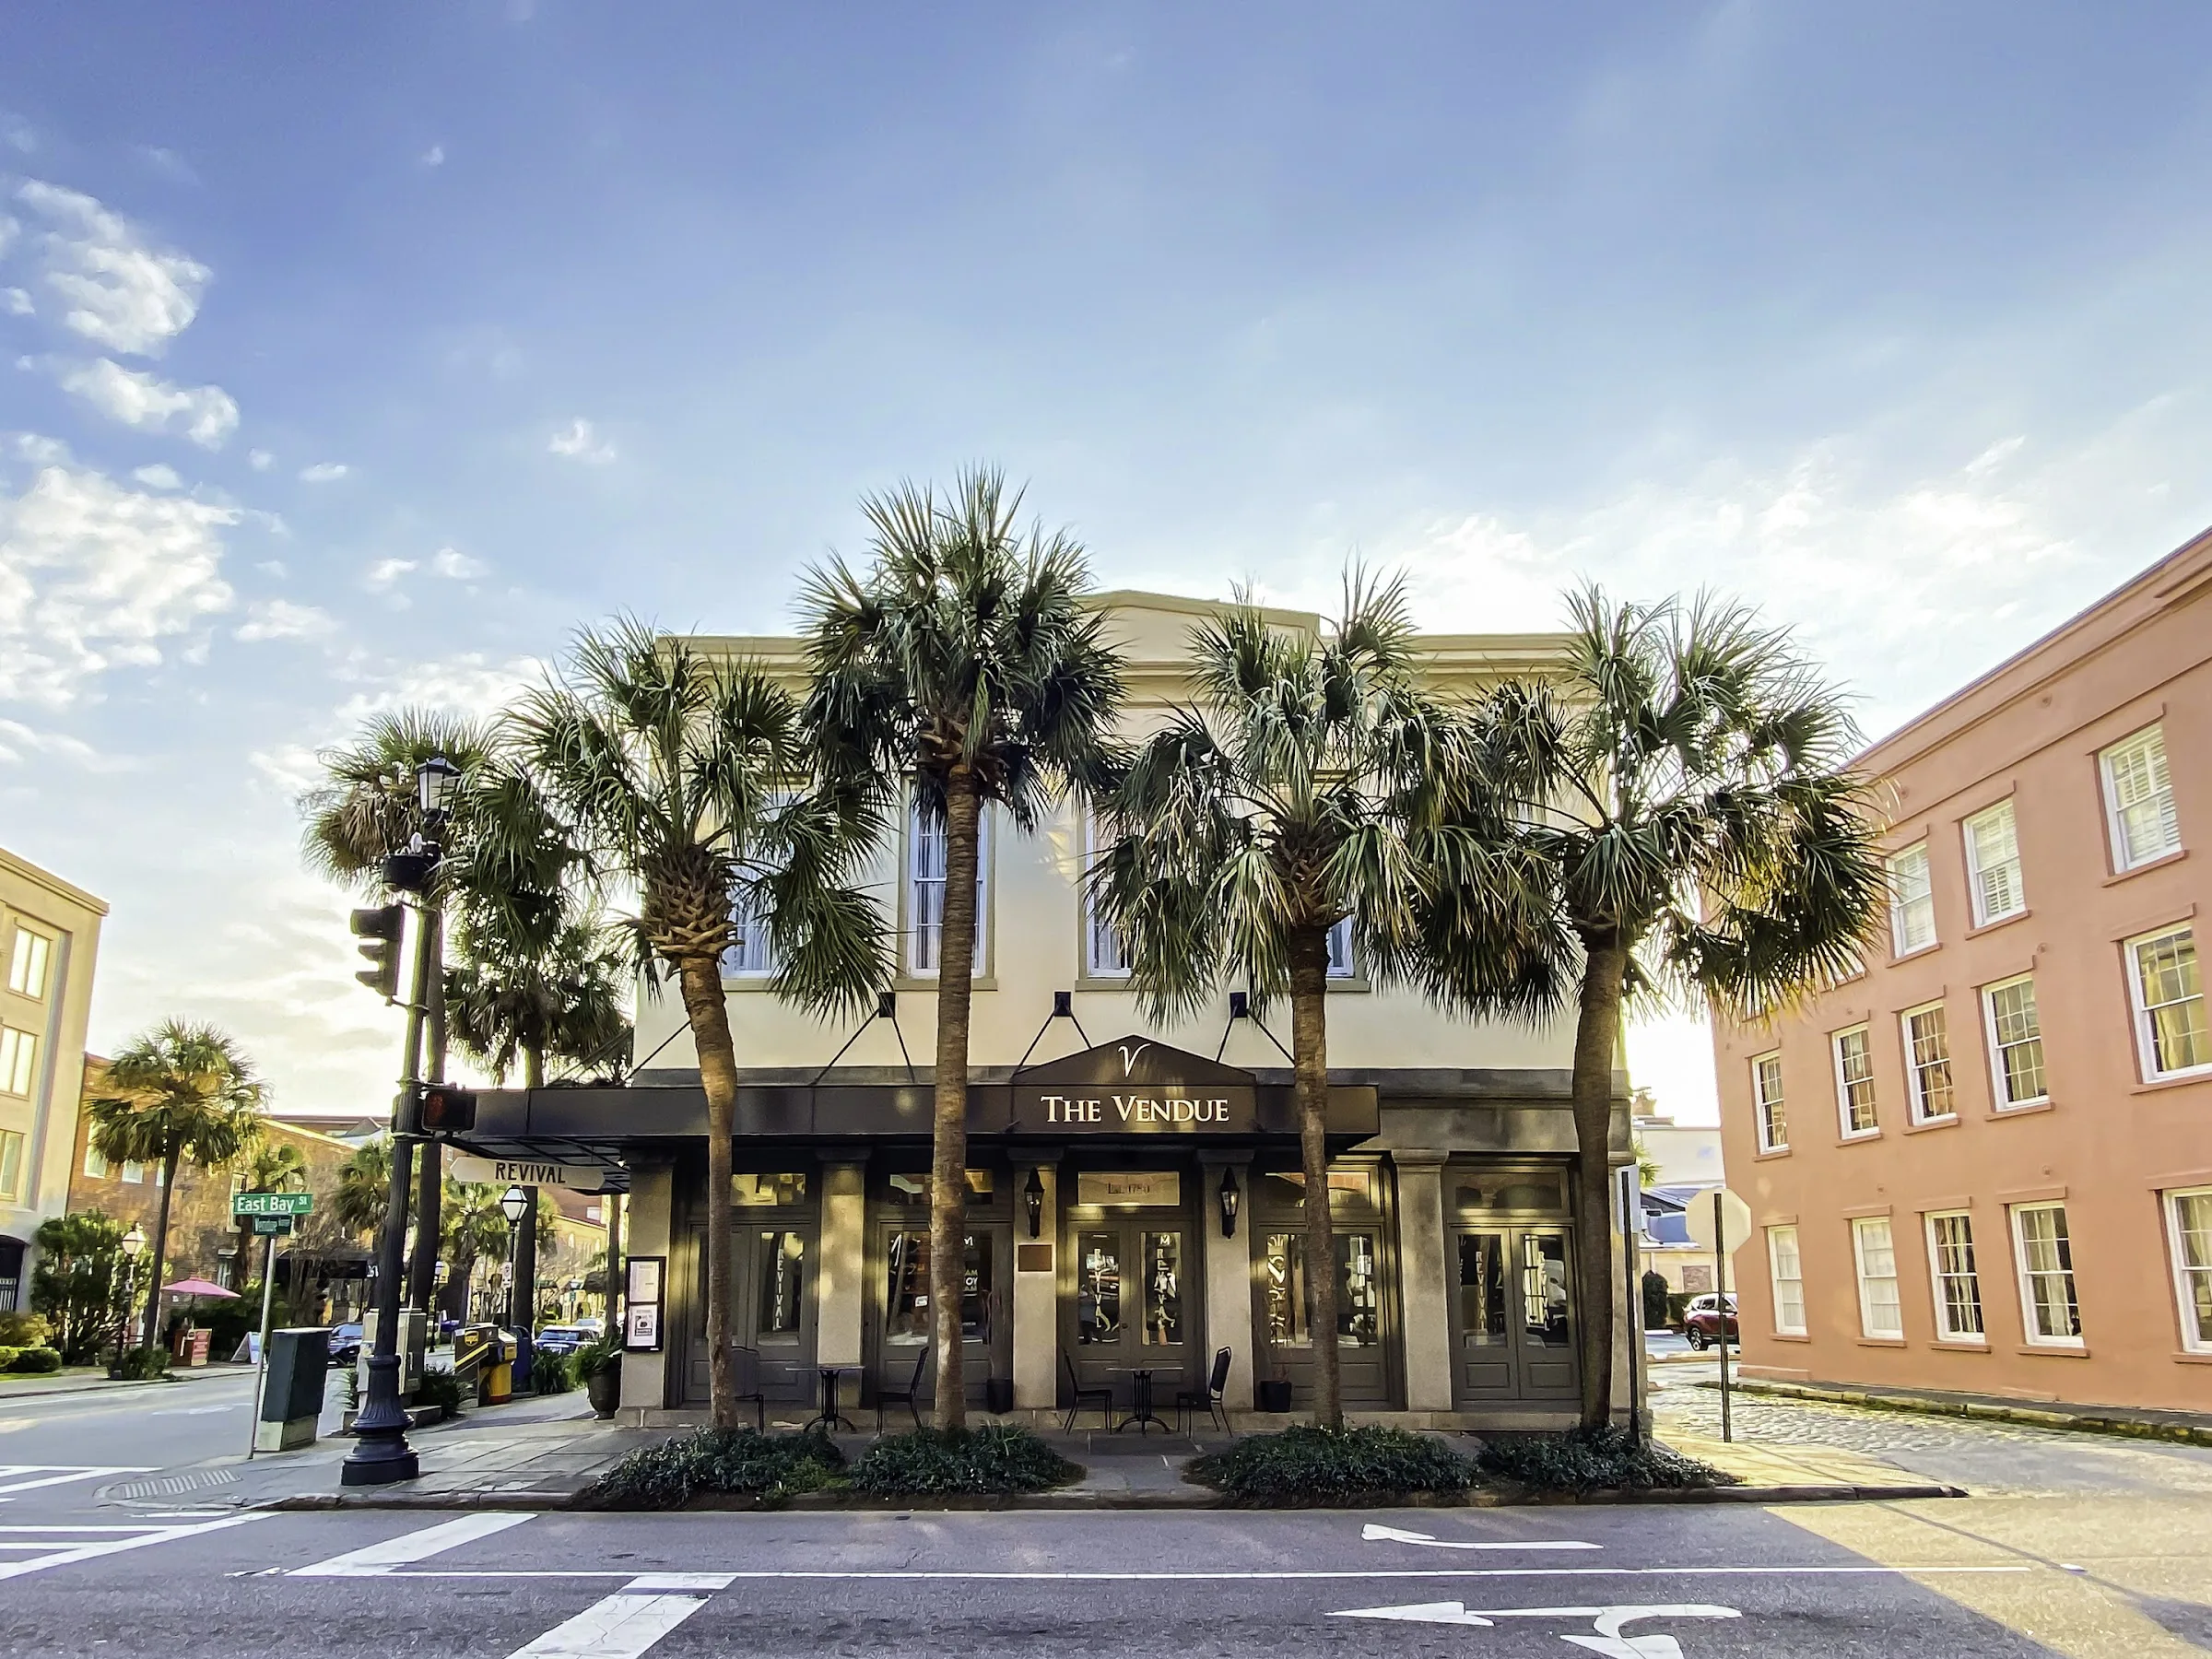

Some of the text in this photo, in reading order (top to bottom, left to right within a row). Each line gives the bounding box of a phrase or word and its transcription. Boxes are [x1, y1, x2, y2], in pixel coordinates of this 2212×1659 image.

[1118, 1042, 1151, 1077] V
[1041, 1095, 1230, 1123] THE VENDUE
[495, 1162, 567, 1184] REVIVAL
[237, 1196, 266, 1212] East
[269, 1195, 295, 1213] Bay
[775, 1248, 784, 1329] REVIVAL
[1094, 1248, 1102, 1328] REVIVAL
[1476, 1251, 1488, 1330] REVIVAL
[1538, 1251, 1550, 1331] REVIVAL
